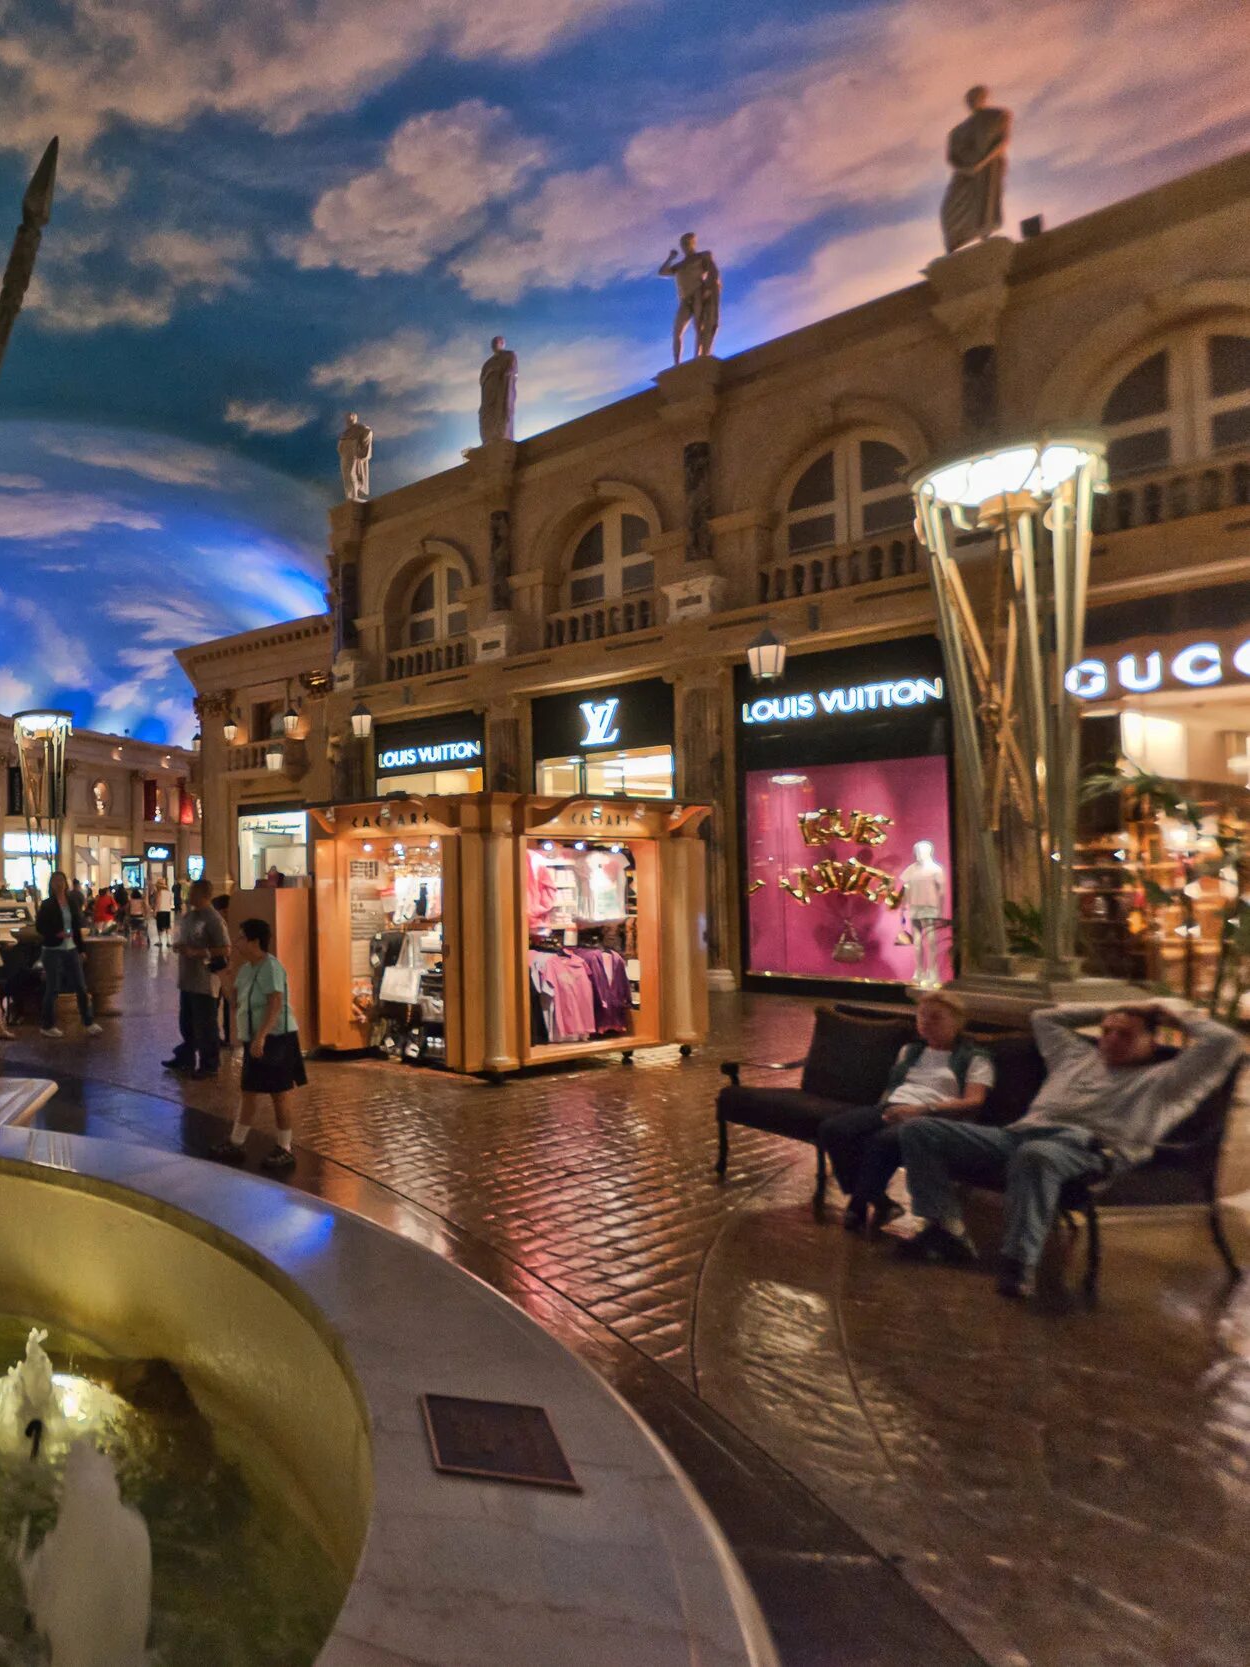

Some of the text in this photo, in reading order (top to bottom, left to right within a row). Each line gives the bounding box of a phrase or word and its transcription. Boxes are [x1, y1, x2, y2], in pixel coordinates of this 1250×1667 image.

[742, 676, 943, 724] LOUIS VUITTON
[378, 740, 481, 769] LOUIS VUITTON
